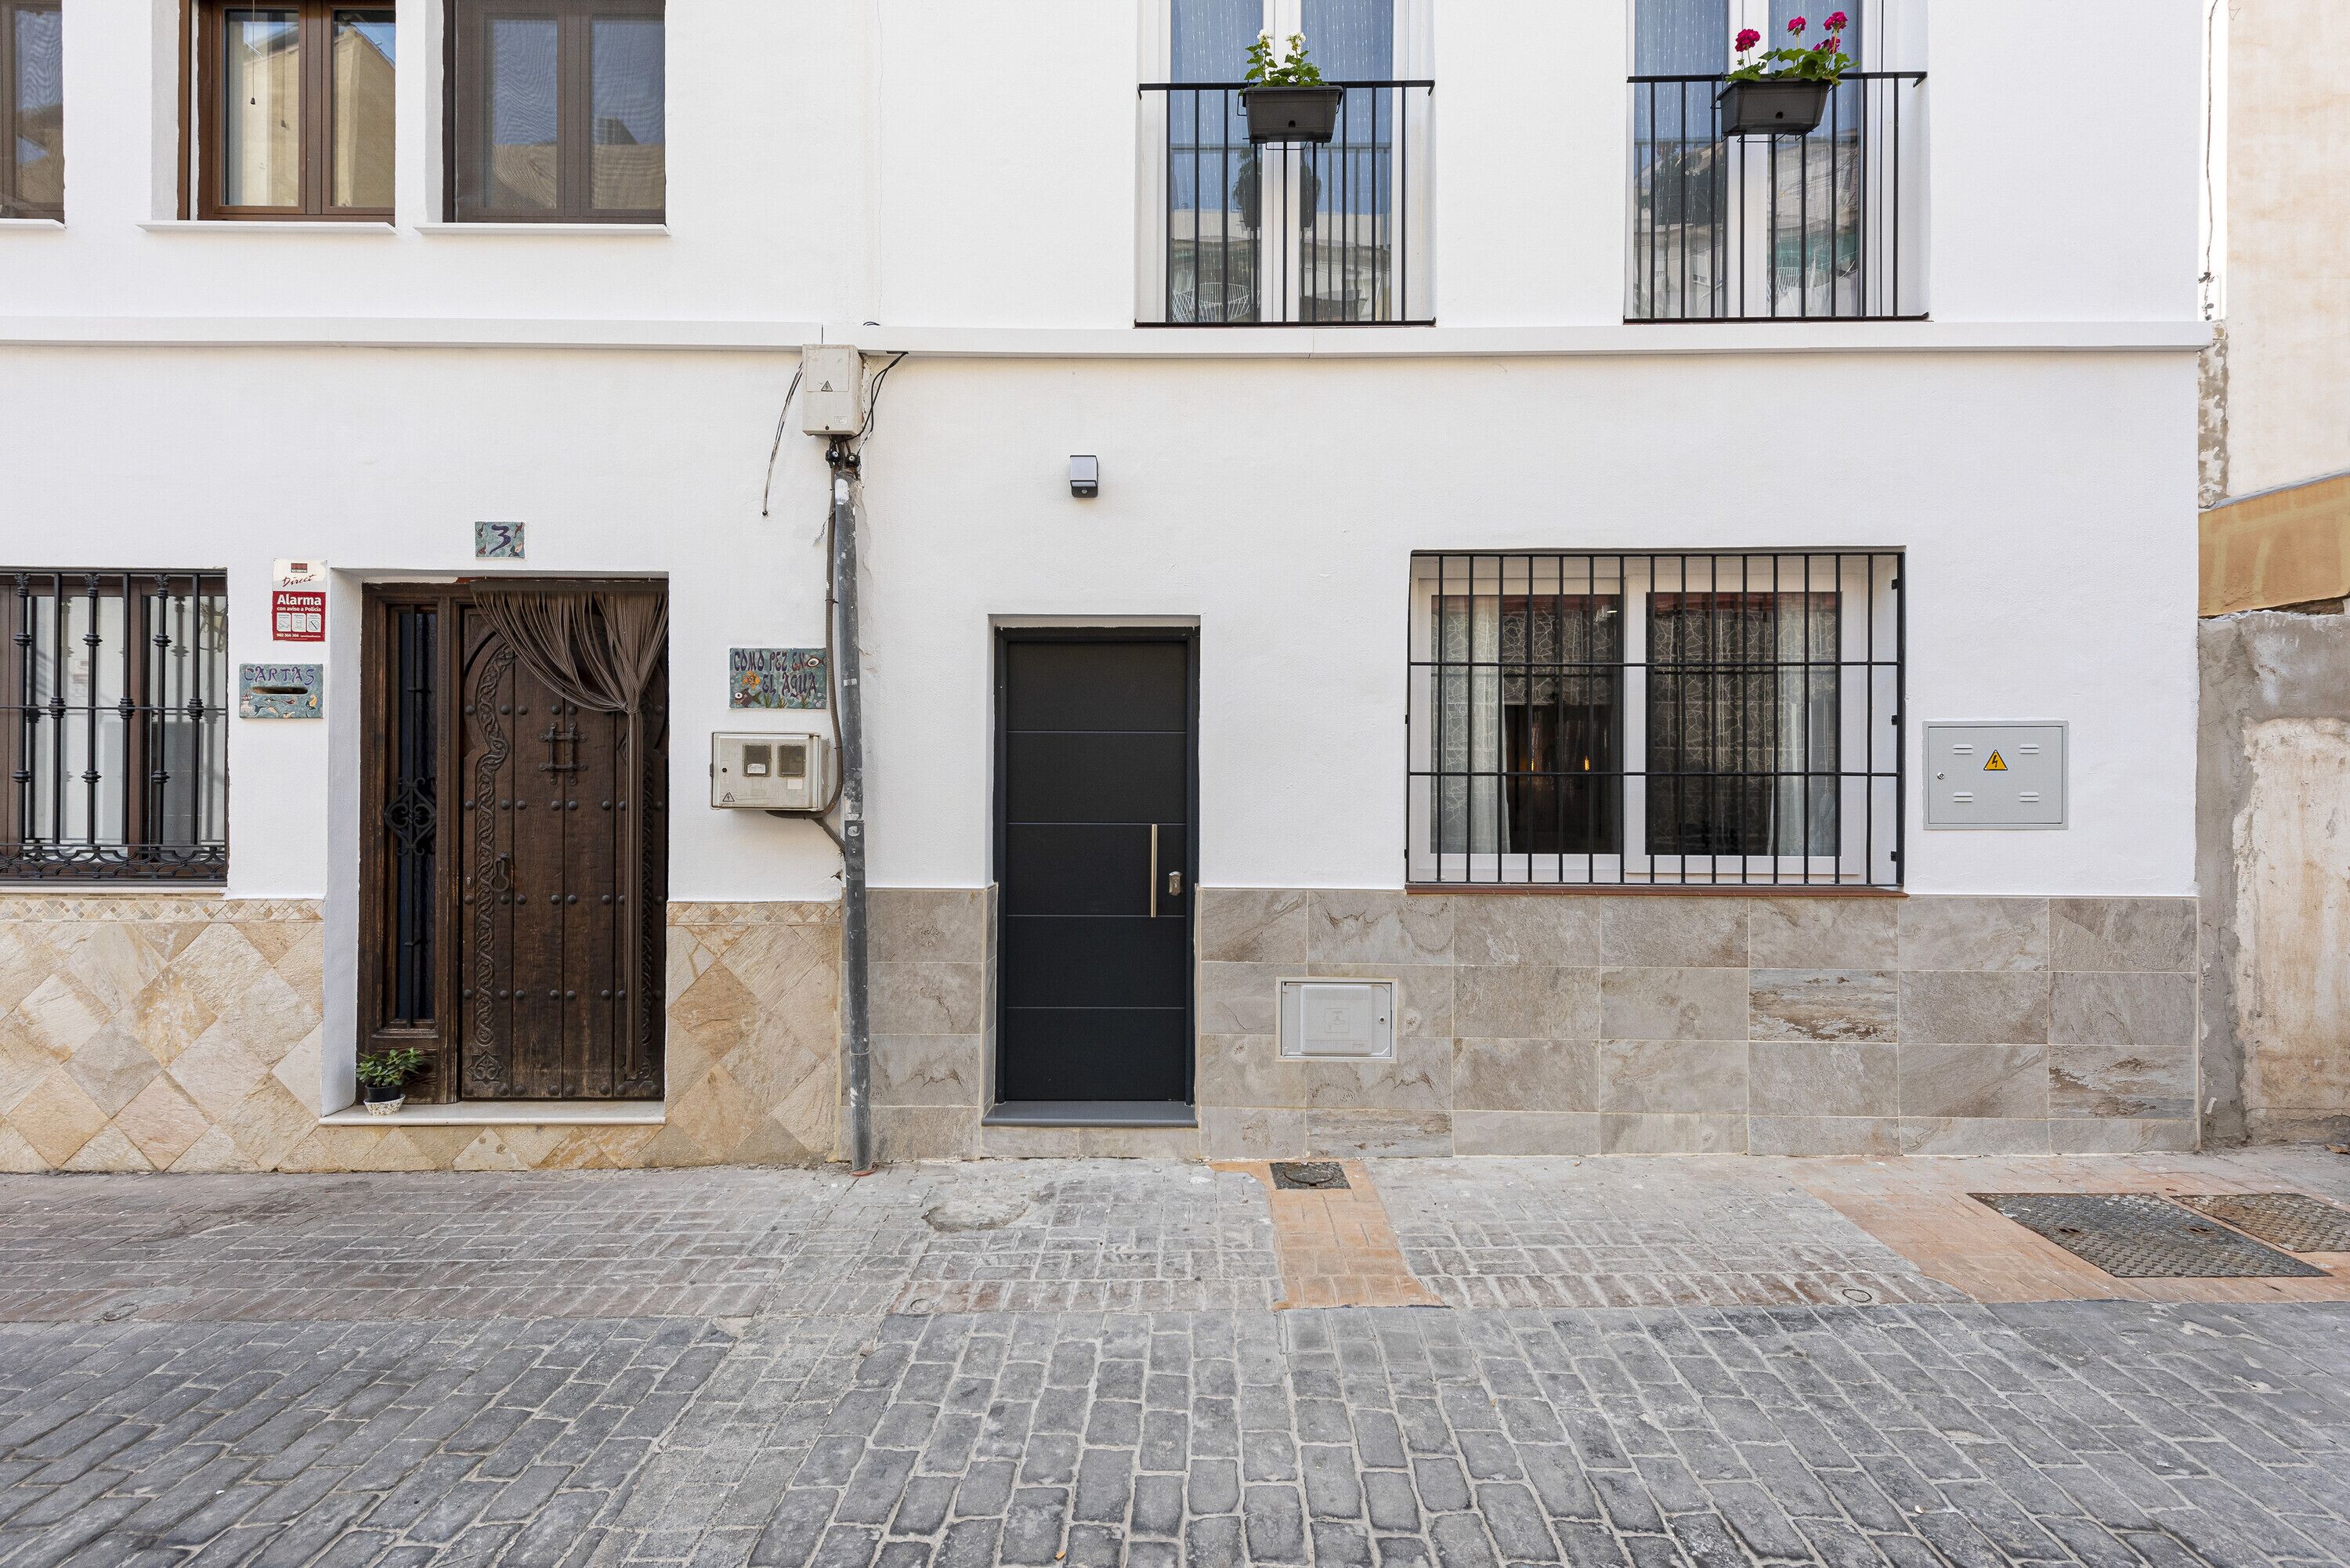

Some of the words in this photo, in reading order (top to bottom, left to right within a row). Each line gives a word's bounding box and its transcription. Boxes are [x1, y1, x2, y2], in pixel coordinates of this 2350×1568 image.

[489, 524, 511, 555] 3
[282, 574, 317, 587] Direct
[277, 594, 322, 605] Alarma
[734, 649, 765, 671] COMO
[769, 651, 787, 671] PEZ
[792, 652, 805, 671] EN
[244, 666, 315, 686] CARTAS
[762, 674, 776, 695] EL
[782, 672, 817, 699] AGUA
